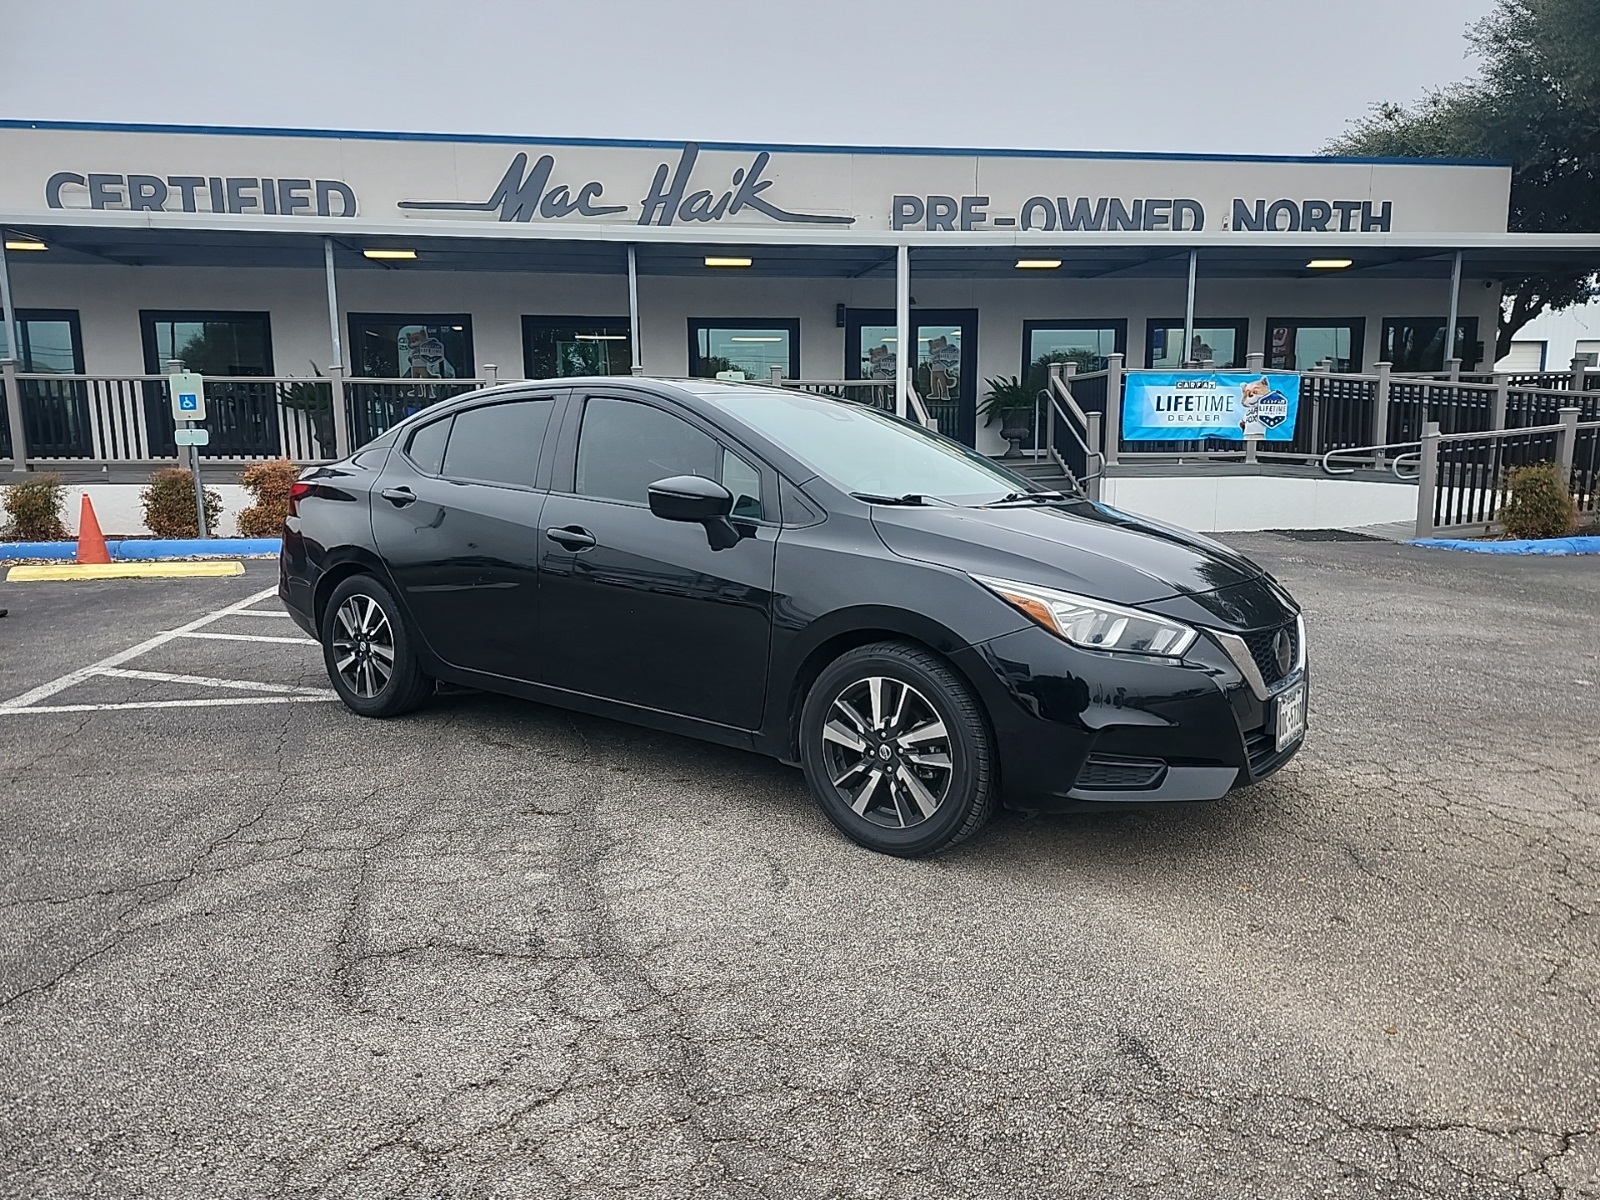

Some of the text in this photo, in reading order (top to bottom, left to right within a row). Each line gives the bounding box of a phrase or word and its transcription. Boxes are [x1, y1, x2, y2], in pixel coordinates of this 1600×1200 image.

[45, 171, 357, 218] CERTIFIED
[398, 141, 856, 227] Mac Haik
[892, 195, 1394, 233] PRE-OWNED NORTH
[1176, 381, 1217, 390] CARFAX
[1155, 395, 1235, 412] LIFETIME
[1167, 414, 1221, 422] DEALER
